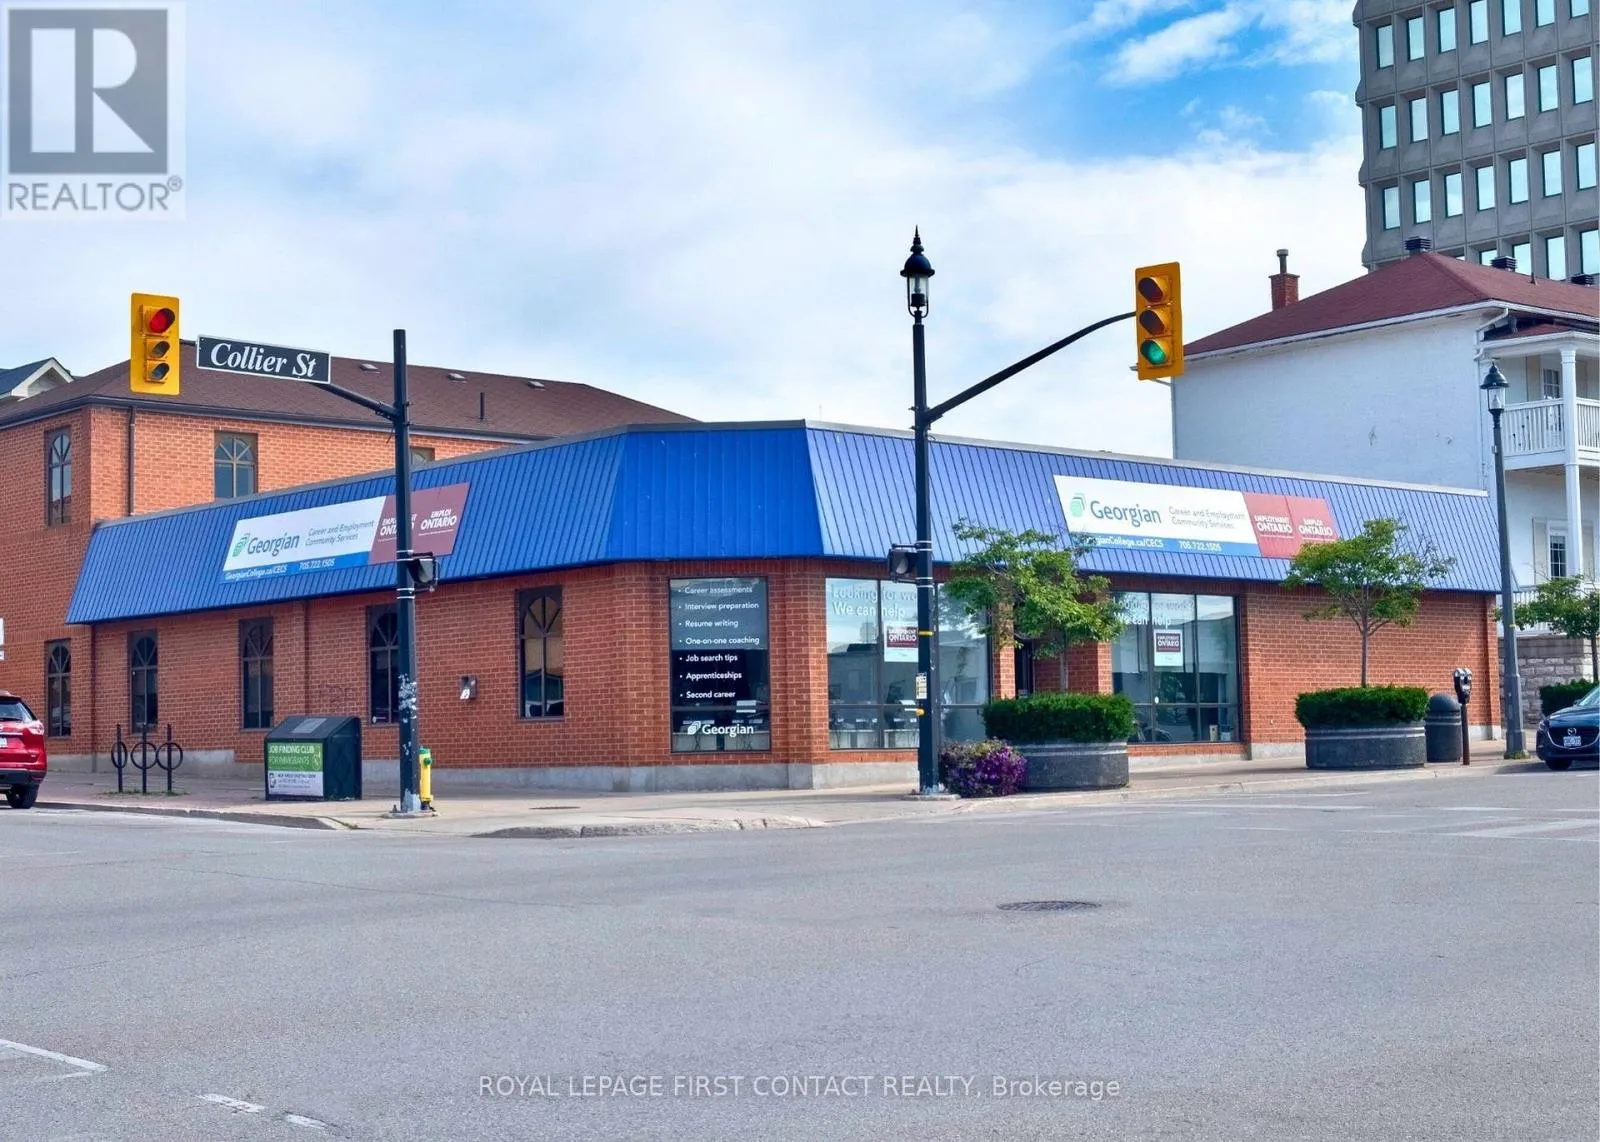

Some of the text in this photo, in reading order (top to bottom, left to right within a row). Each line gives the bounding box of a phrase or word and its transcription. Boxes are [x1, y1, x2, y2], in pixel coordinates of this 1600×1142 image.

[210, 343, 317, 377] Collier St
[430, 508, 452, 519] EMPLOI
[1090, 500, 1162, 528] Georgian
[1169, 506, 1246, 522] Career and Employment
[420, 516, 457, 530] ONTARIO
[1172, 516, 1234, 529] Community Services
[1254, 515, 1290, 524] EMPLOYMENT
[308, 520, 375, 537] Career and Employment
[1257, 522, 1293, 533] ONTARIO
[1299, 525, 1333, 536] ONTARIO
[247, 532, 300, 557] Georgian
[305, 532, 359, 547] Community Services
[1179, 540, 1222, 552] 705.722.1505
[299, 558, 336, 571] 705.722.1505
[684, 586, 753, 595] Career assessments
[831, 583, 878, 603] Looking
[883, 587, 897, 600] for
[684, 601, 760, 612] Interview preparation
[832, 602, 905, 619] We can help
[685, 619, 739, 629] Resume writing
[685, 636, 760, 646] One-on-one coaching
[889, 634, 917, 642] ONTARIO
[685, 653, 738, 664] Job search tips
[685, 671, 743, 682] Apprenticeships
[685, 690, 736, 699] Second career
[701, 723, 754, 738] Georgian
[279, 745, 301, 754] FINDING
[301, 745, 315, 754] CLUB
